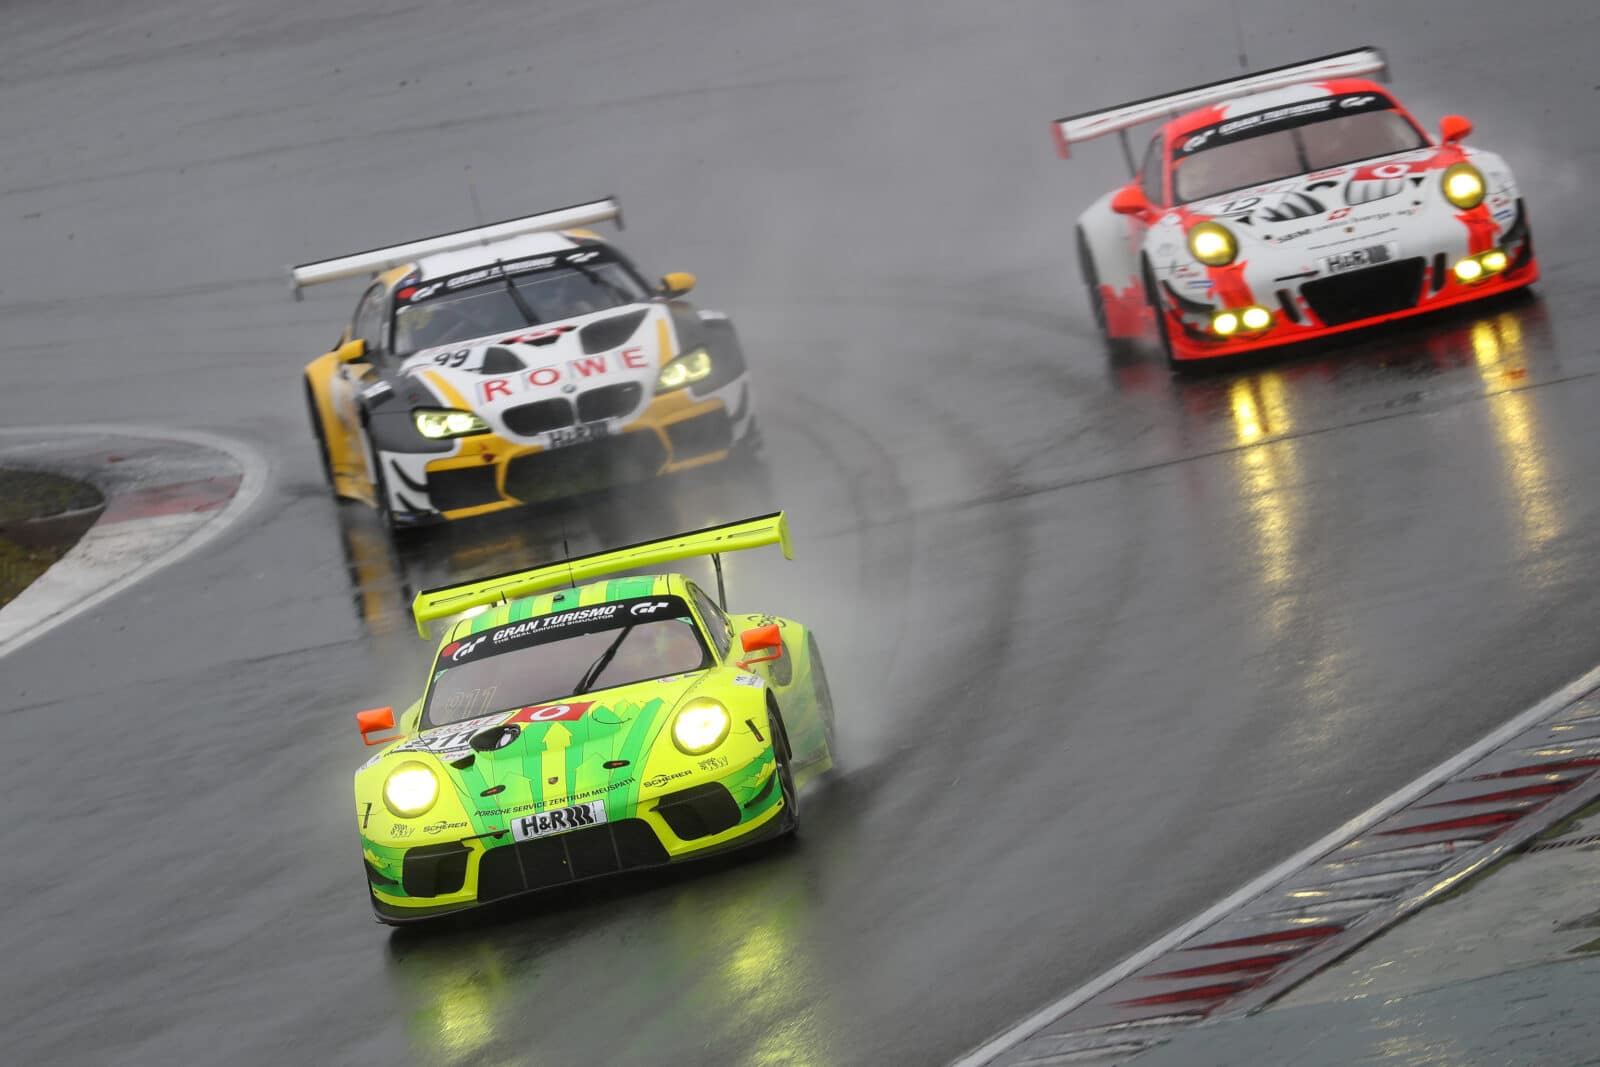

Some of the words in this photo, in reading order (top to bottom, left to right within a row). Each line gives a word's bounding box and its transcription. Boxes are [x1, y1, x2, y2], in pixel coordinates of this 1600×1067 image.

[433, 349, 472, 368] 99
[483, 348, 650, 402] ROWE
[493, 620, 538, 641] GRAN
[532, 621, 566, 634] DRIVING
[567, 614, 614, 626] SIMULATOR
[643, 769, 693, 788] SCHERER
[474, 807, 512, 817] PORSCHE
[512, 801, 548, 813] SERVICE
[549, 793, 591, 806] ZENTRUM
[591, 776, 637, 795] MEUSPATH
[423, 820, 468, 835] SCHERER
[520, 810, 567, 837] H&R
